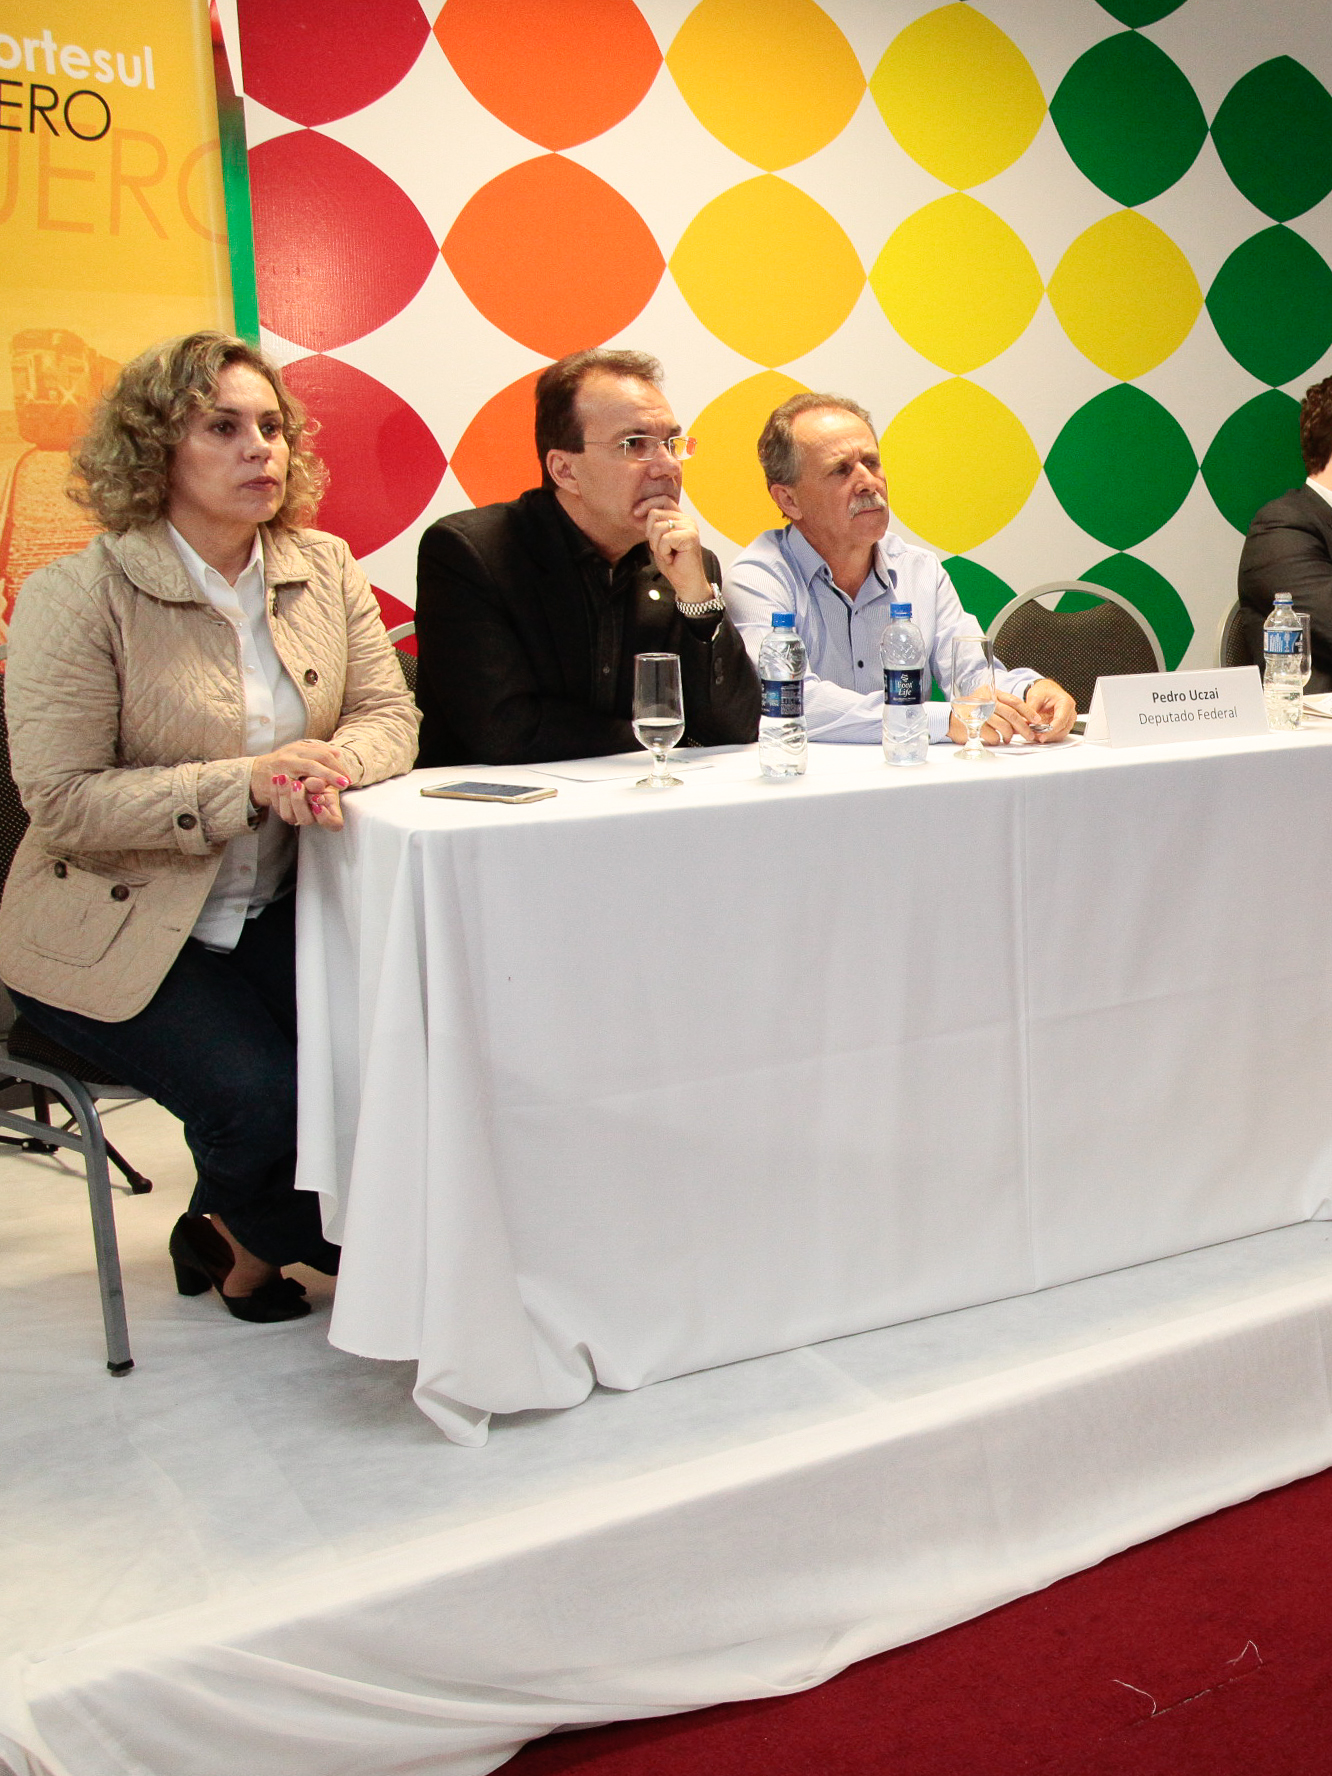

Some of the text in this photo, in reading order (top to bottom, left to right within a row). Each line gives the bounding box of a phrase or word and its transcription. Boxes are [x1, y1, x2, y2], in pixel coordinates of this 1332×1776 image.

[0, 28, 155, 90] ortesul
[1152, 688, 1219, 704] Pedro Uczai
[1139, 706, 1238, 727] Deputado Federal
